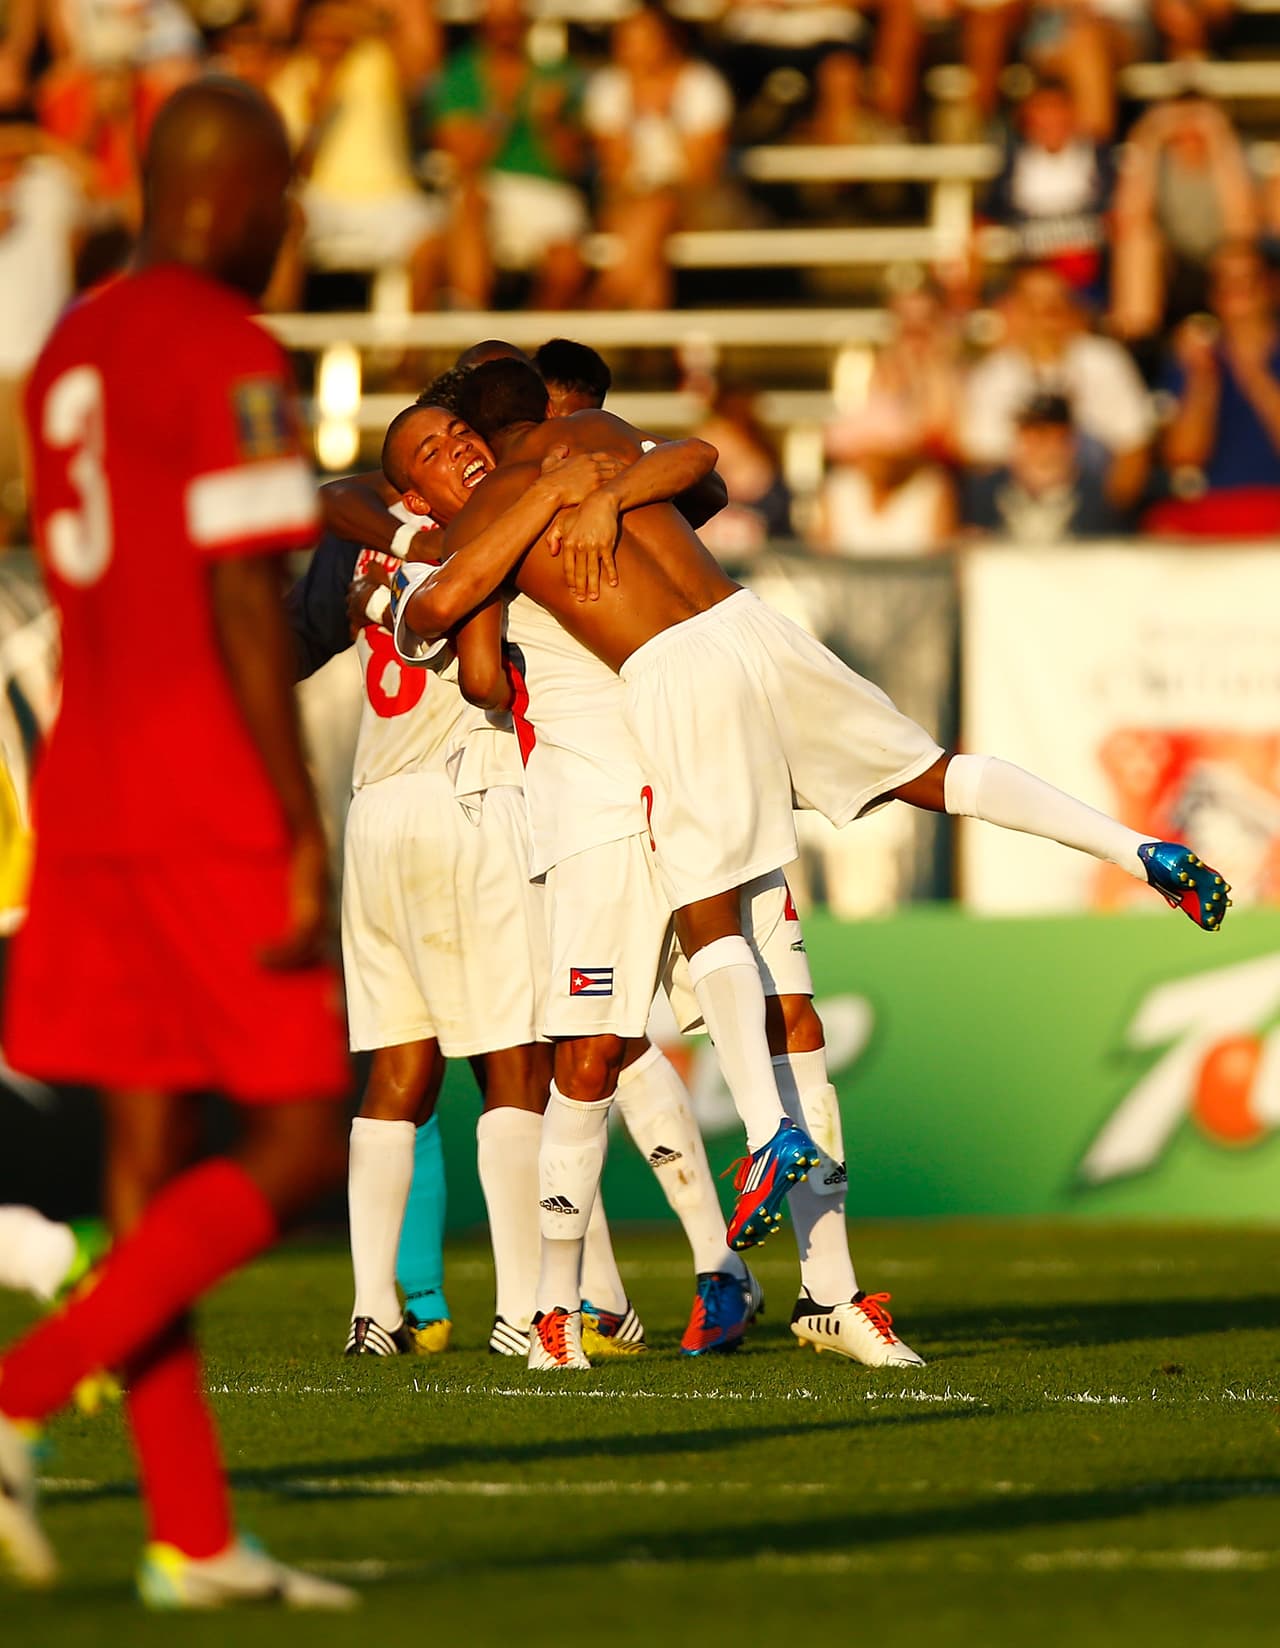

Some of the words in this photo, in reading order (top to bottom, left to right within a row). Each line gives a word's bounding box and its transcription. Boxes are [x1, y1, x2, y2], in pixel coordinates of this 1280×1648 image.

[41, 363, 114, 588] 3
[364, 623, 427, 719] 8
[539, 1200, 580, 1215] adidas
